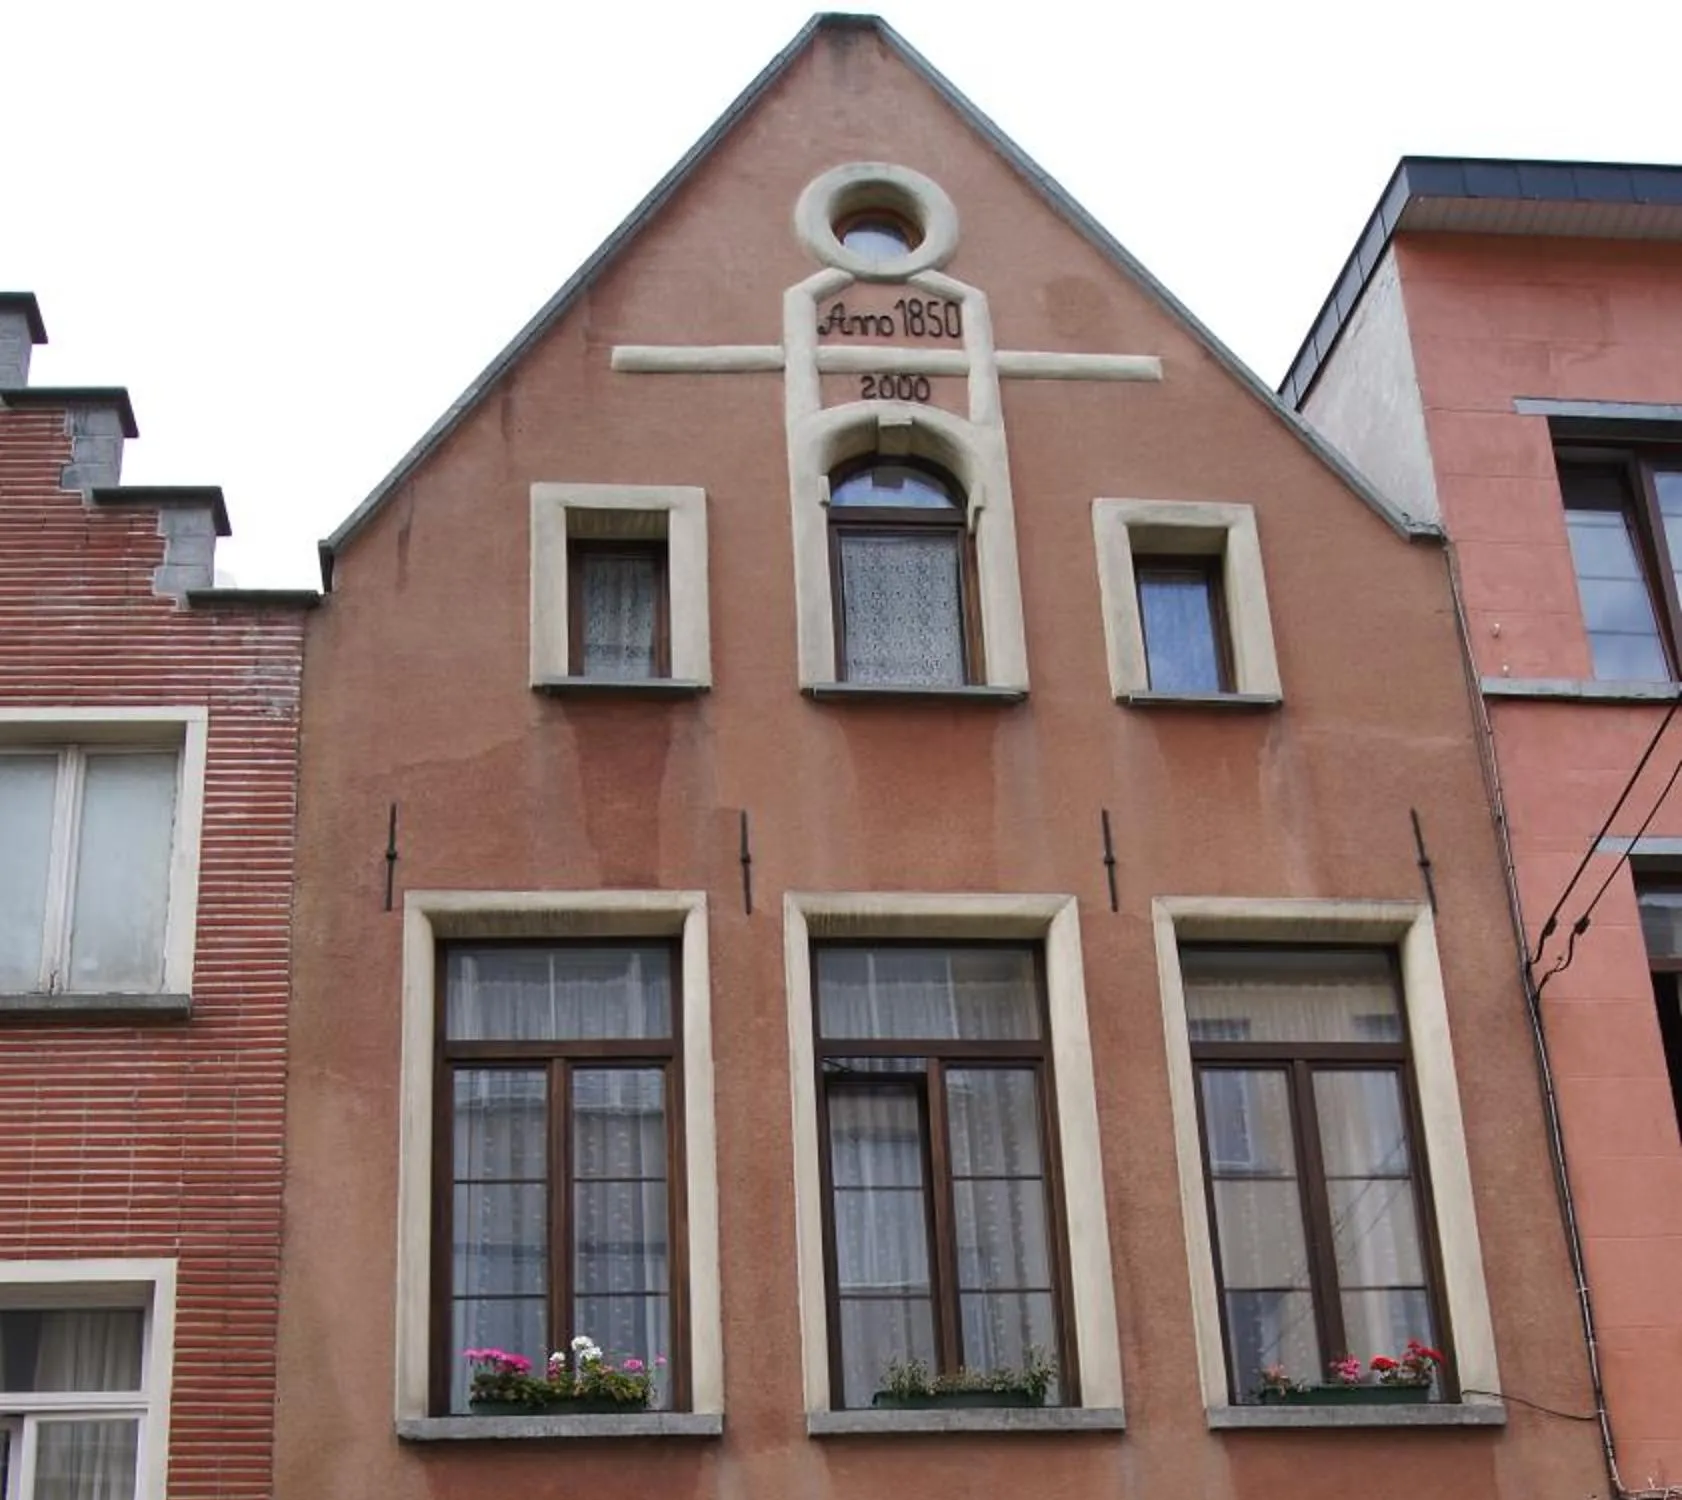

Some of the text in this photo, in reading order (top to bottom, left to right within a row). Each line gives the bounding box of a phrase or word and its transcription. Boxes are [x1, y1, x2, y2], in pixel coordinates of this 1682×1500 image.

[817, 298, 962, 338] Anno 1850
[861, 374, 931, 401] 2000
